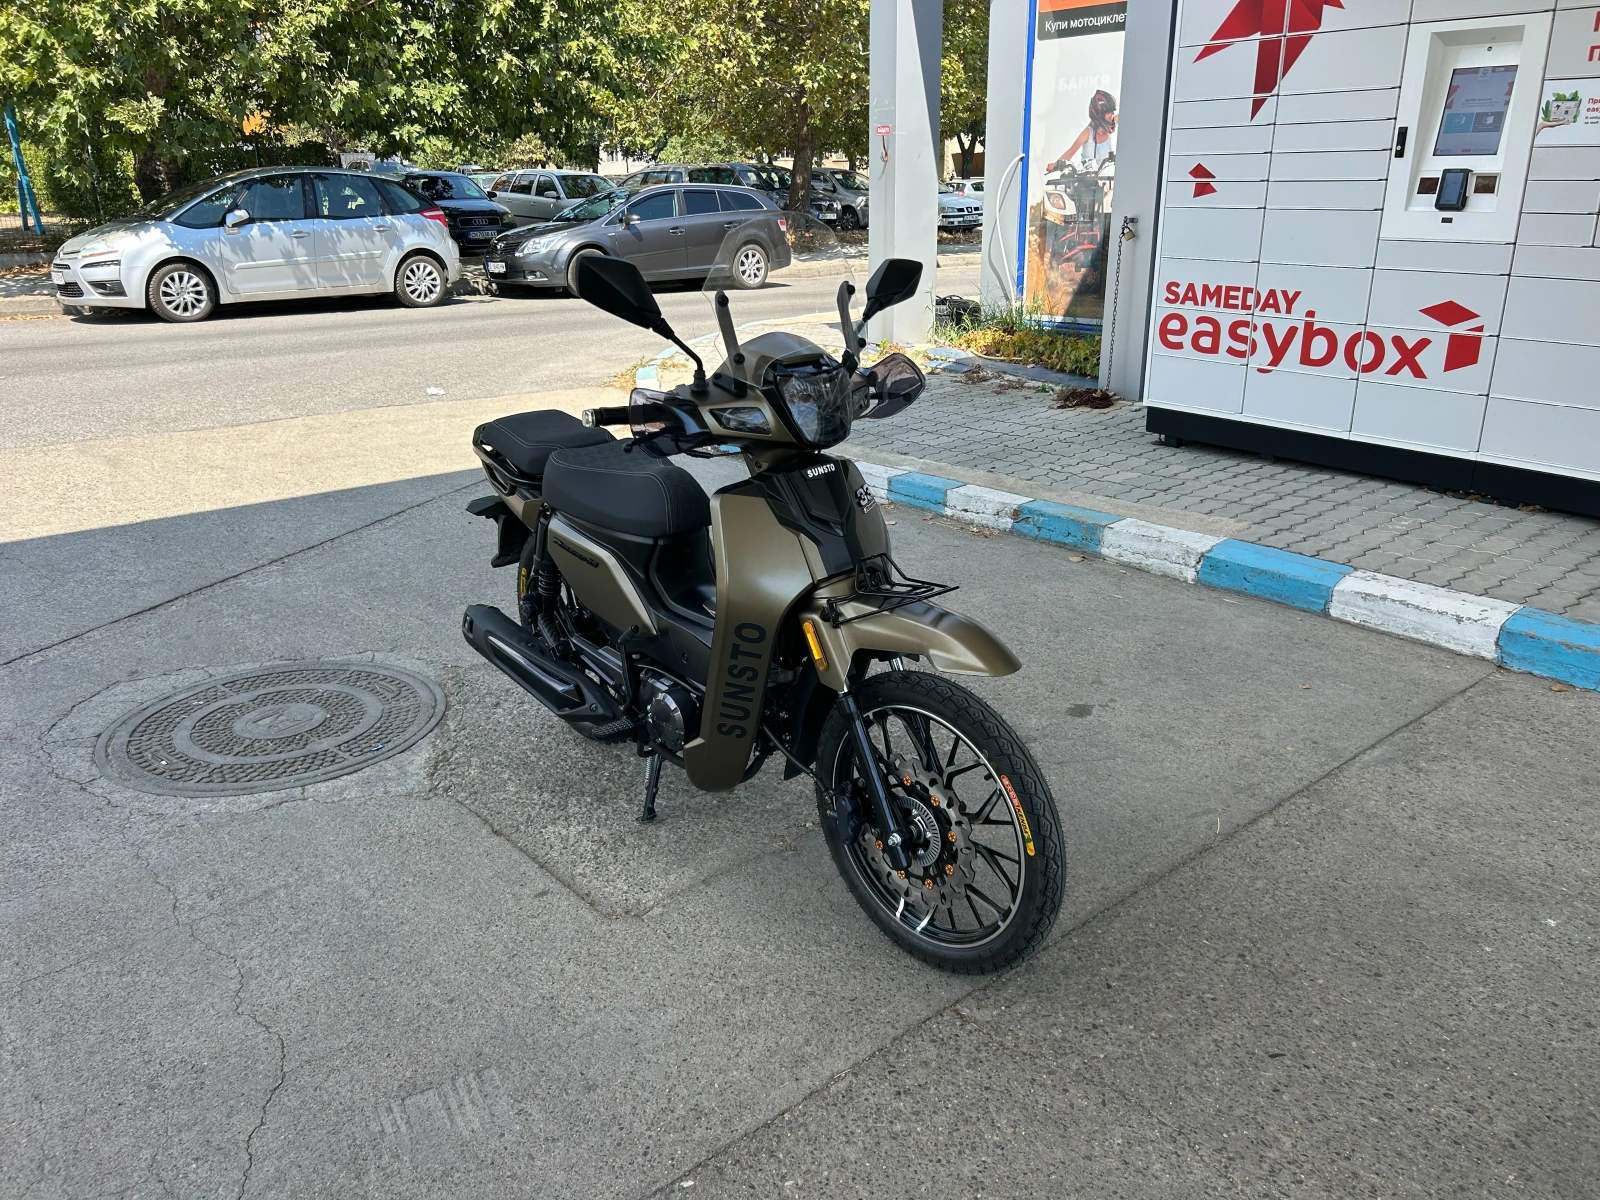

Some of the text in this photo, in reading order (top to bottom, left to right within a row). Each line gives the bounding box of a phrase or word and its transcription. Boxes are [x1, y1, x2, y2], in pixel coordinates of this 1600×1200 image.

[1045, 20, 1068, 33] Купи
[1164, 281, 1302, 314] SAMEDAY
[1158, 310, 1433, 379] easybox
[807, 463, 836, 478] SUNSTO
[716, 622, 767, 739] SUNSTO
